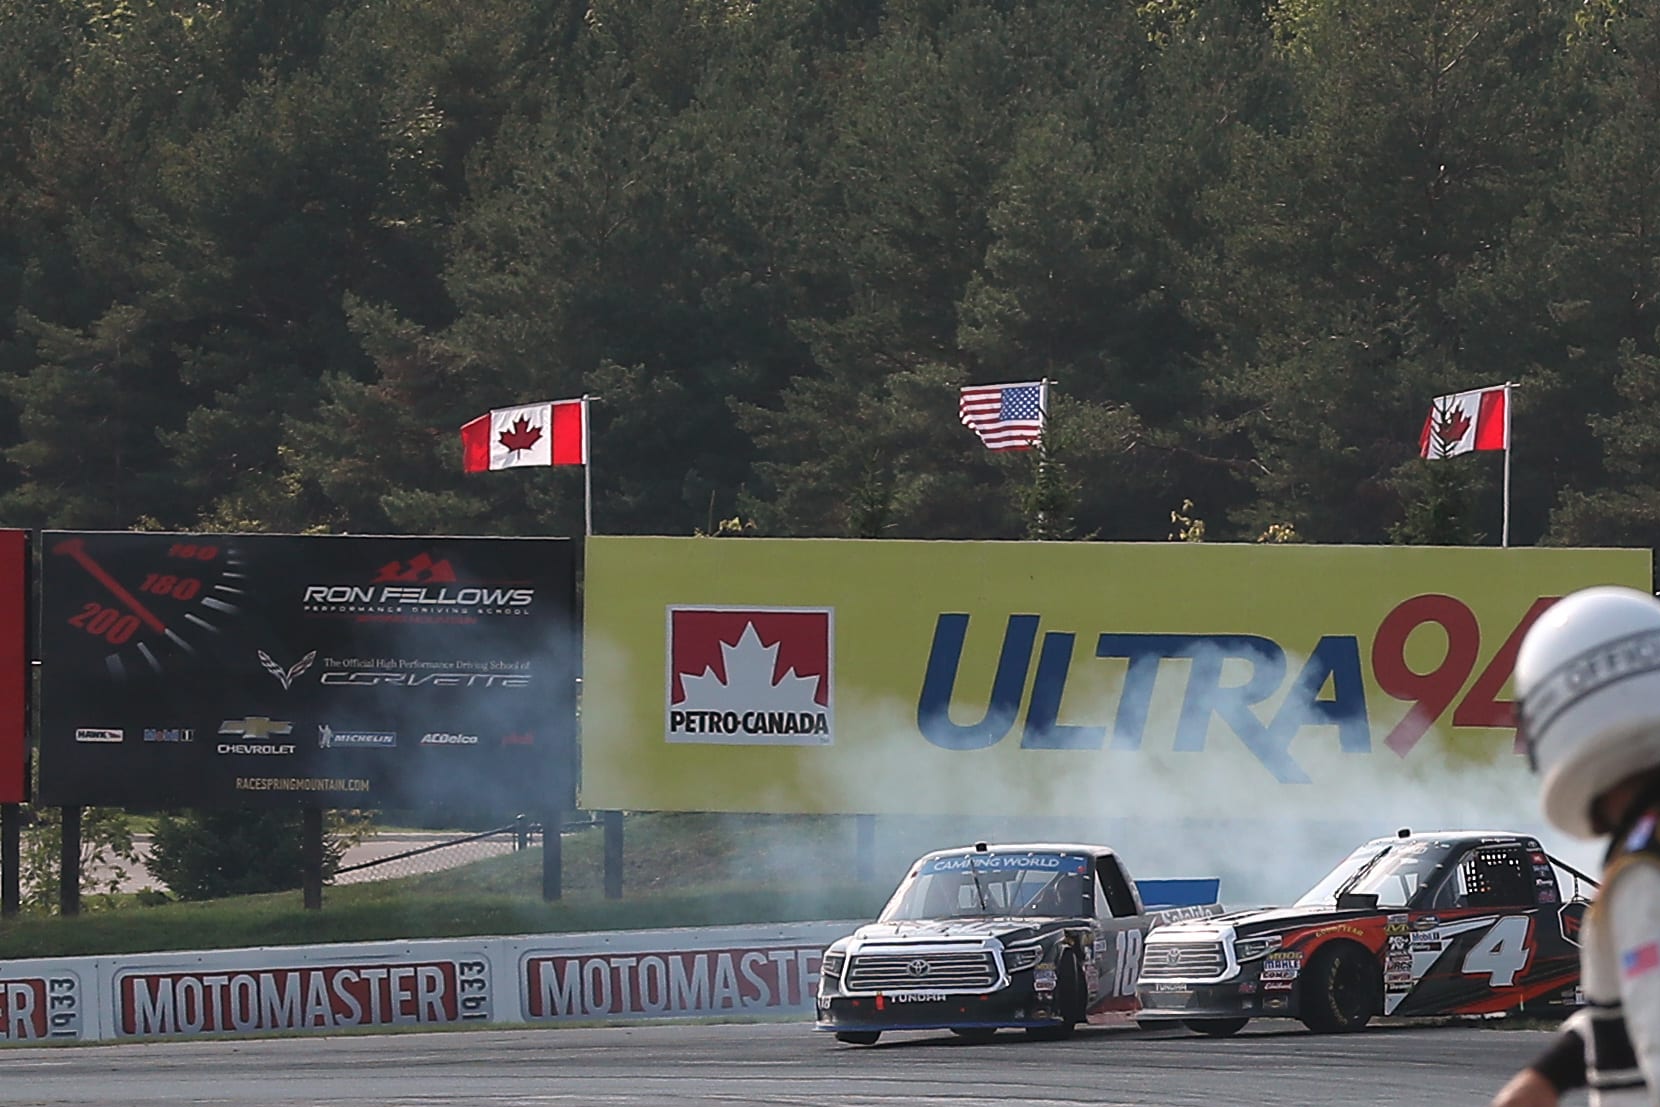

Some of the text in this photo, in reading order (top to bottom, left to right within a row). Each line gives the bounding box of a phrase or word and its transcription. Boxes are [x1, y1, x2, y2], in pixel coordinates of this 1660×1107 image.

[140, 574, 201, 600] 180
[304, 587, 534, 605] RON FELLOWS
[68, 602, 141, 644] 200
[320, 672, 532, 688] CORVETTE
[916, 612, 1372, 784] ULTRA
[217, 744, 296, 754] CHEVROLET
[335, 734, 393, 743] MICHELIN
[236, 778, 370, 792] RACESPRINGMOUNTAIN.COM
[934, 858, 1059, 870] CAMPING WORLD
[1113, 929, 1142, 997] 18
[1461, 915, 1530, 987] 4
[132, 966, 448, 1034] MOTOMASTER
[459, 960, 488, 1020] 1933
[50, 978, 77, 1037] 1933
